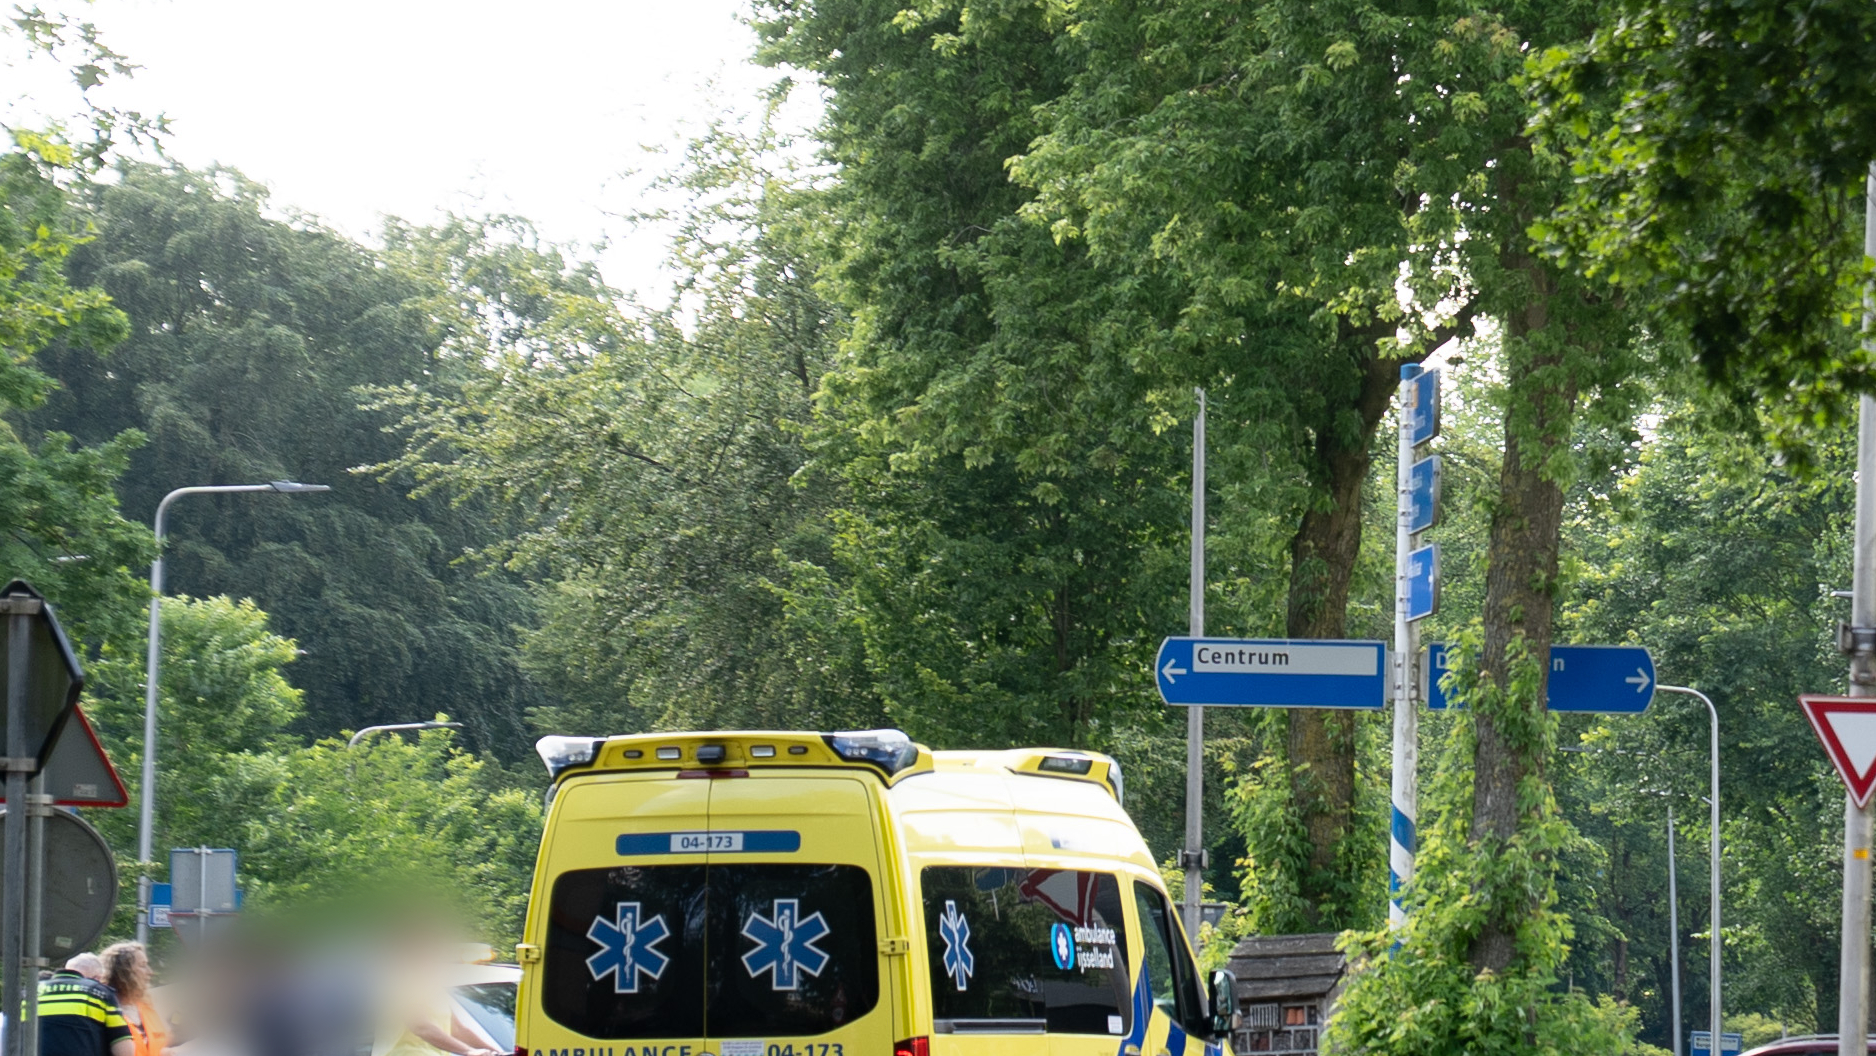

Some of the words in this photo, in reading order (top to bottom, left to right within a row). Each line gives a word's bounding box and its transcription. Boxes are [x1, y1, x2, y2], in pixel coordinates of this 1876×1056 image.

[1197, 647, 1290, 666] Centrum
[681, 835, 733, 850] 04-173
[1074, 922, 1115, 944] ambulance
[1076, 946, 1114, 973] ijsselland
